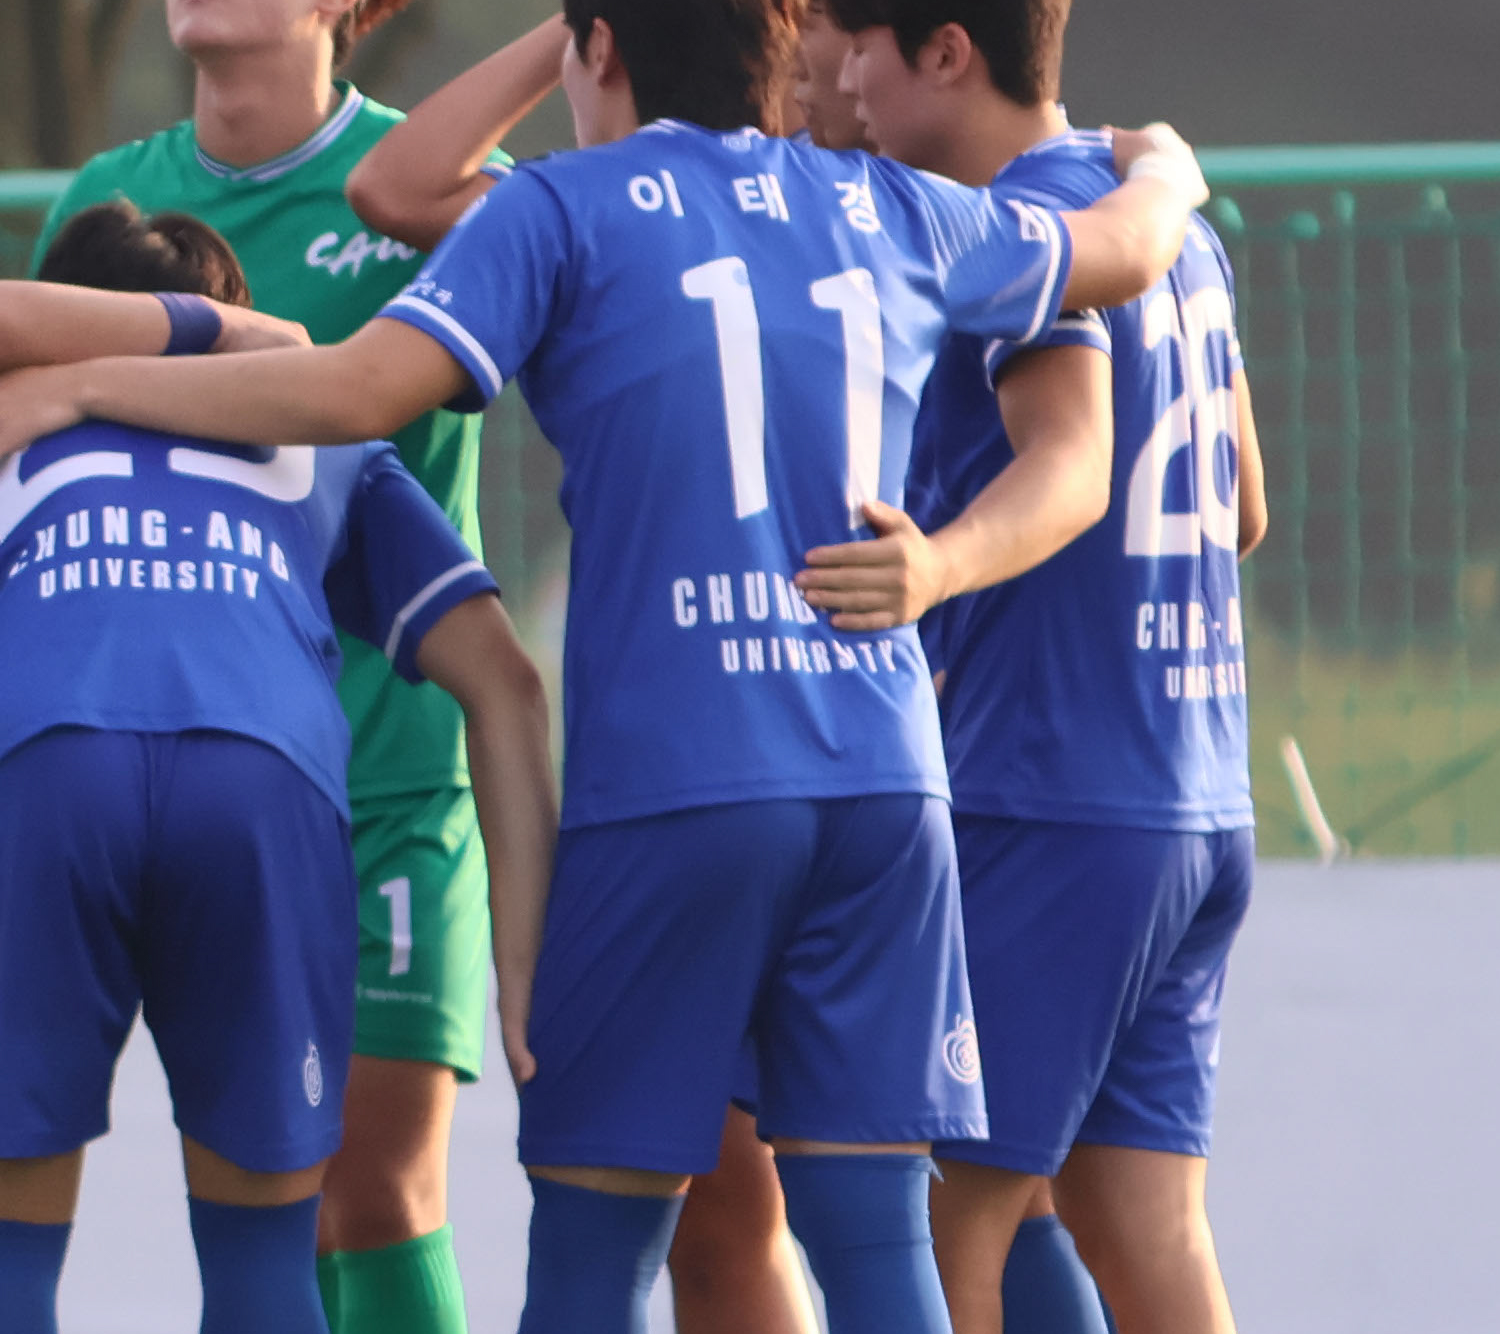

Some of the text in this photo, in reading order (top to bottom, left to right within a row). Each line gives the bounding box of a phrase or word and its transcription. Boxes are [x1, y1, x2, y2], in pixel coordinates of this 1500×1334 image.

[681, 255, 886, 532] 11
[39, 557, 260, 599] UNIVERSITY
[379, 875, 412, 977] 1
